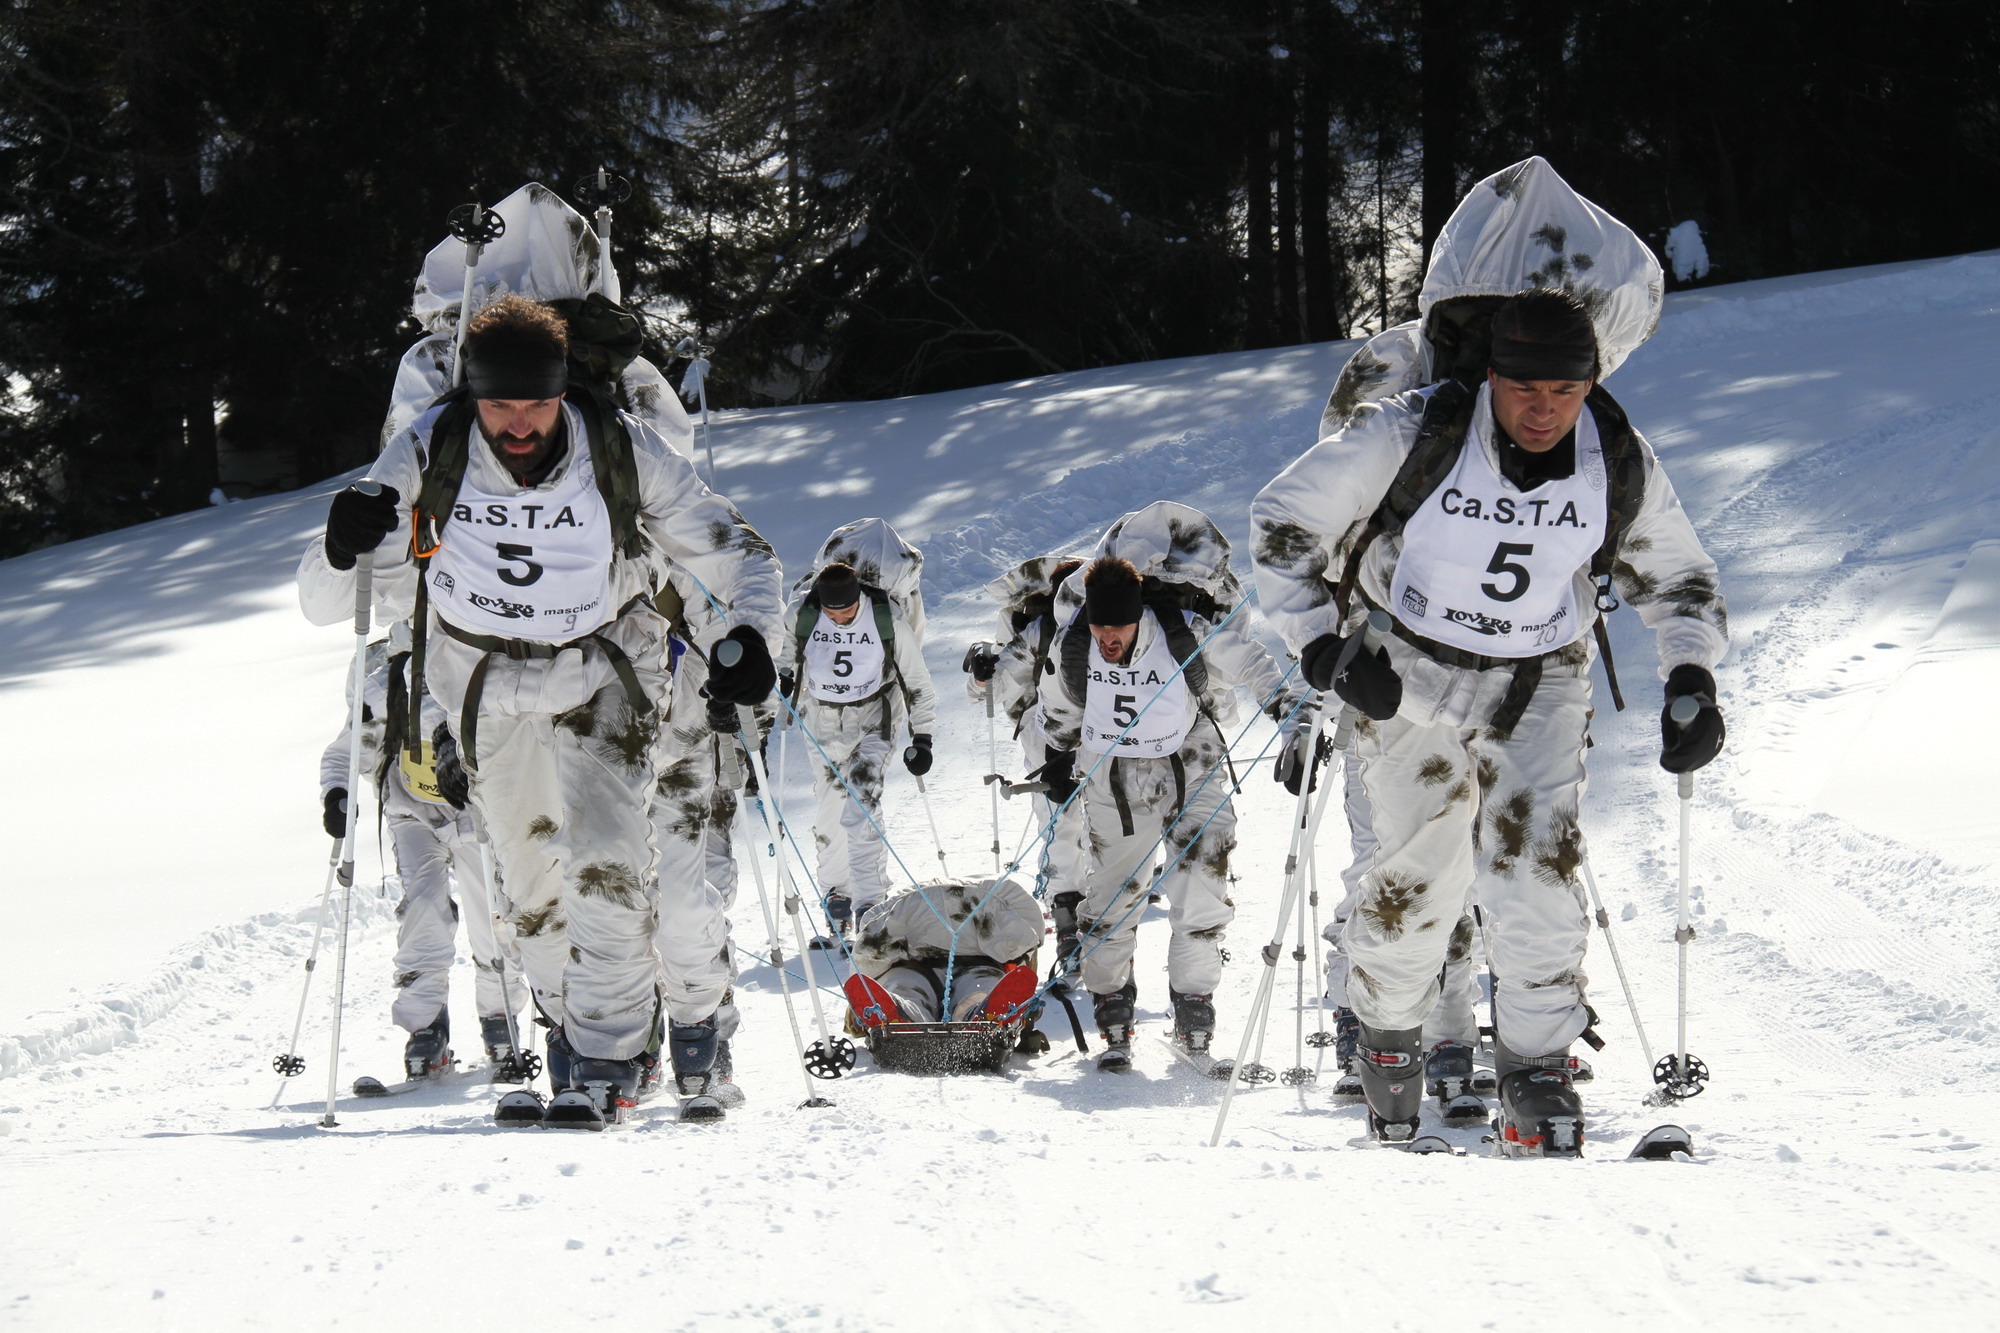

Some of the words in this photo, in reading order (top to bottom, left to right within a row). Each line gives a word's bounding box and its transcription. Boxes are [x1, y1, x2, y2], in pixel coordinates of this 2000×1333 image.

[453, 503, 584, 530] a.S.T.A.
[1441, 488, 1588, 529] Ca.S.T.A.
[496, 541, 544, 587] 5
[1480, 541, 1535, 603] 5
[543, 597, 600, 616] mascioni
[813, 630, 874, 645] Ca.S.T.A.
[1533, 625, 1558, 647] 10
[833, 651, 853, 677] 5
[1113, 694, 1140, 728] 5
